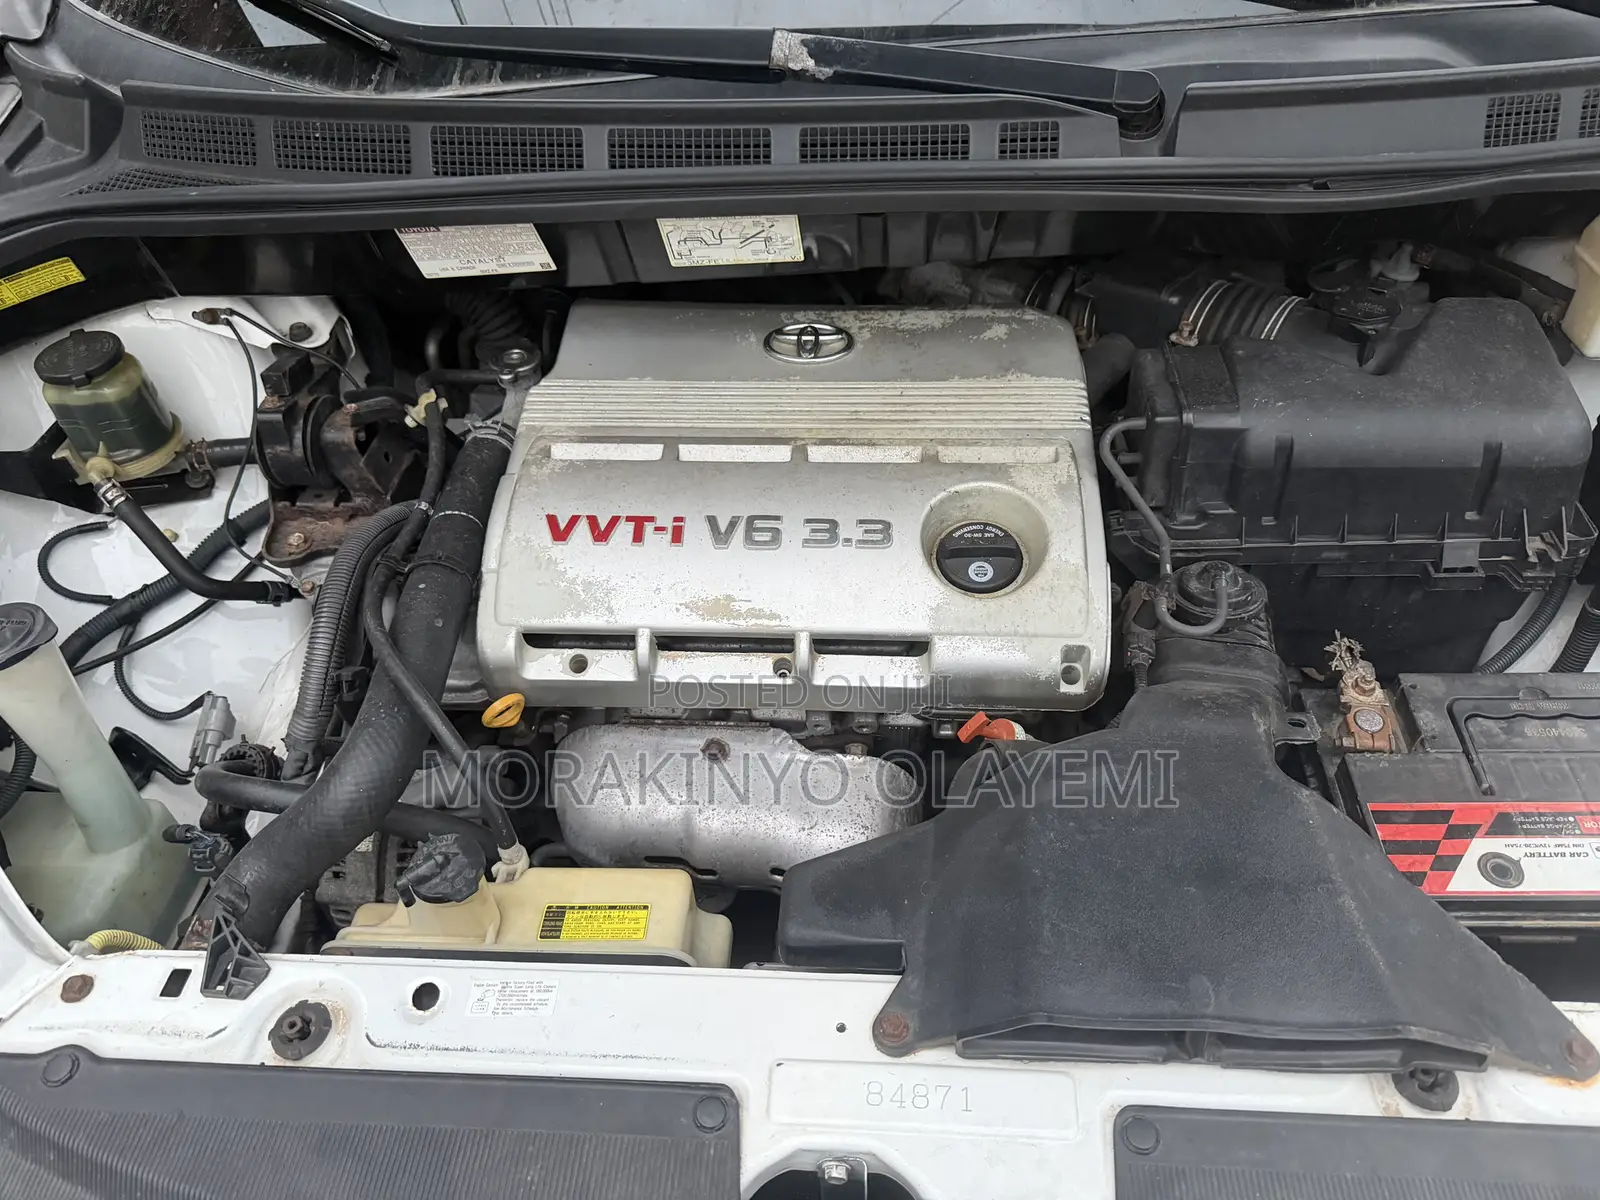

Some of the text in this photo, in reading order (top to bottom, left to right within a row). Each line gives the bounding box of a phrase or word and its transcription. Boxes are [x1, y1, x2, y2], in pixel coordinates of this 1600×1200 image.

[459, 256, 507, 266] CATALYST
[546, 514, 894, 550] VVT-i V6 3.3
[952, 524, 1005, 539] ENERGY CONSERVING
[866, 1081, 973, 1112] 84871
